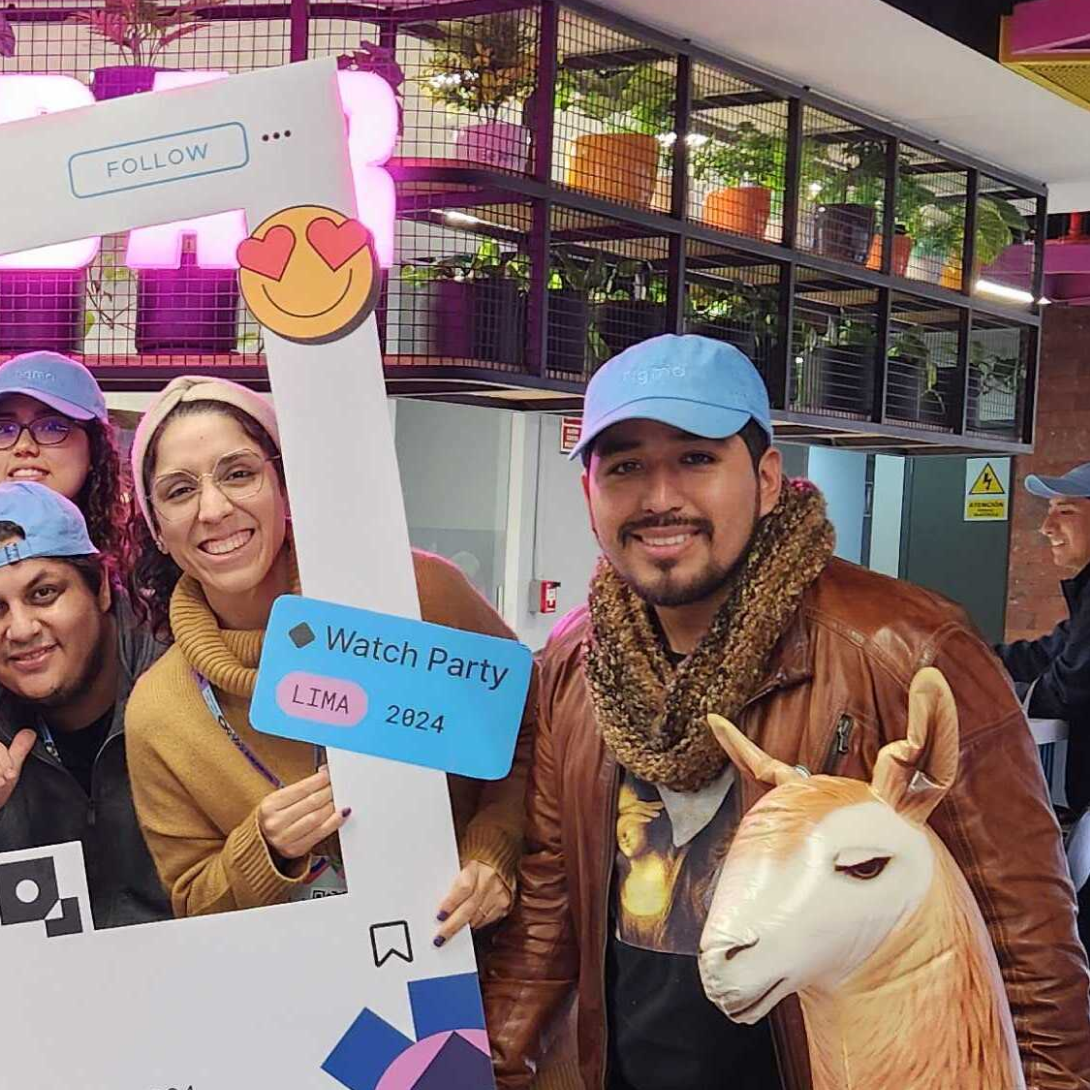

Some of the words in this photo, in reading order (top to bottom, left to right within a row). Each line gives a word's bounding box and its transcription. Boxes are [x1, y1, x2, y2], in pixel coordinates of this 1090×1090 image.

[105, 142, 209, 178] FOLLOW
[326, 624, 419, 668] Watch
[427, 647, 510, 691] Party
[291, 684, 351, 715] LIMA
[386, 704, 445, 735] 2024
